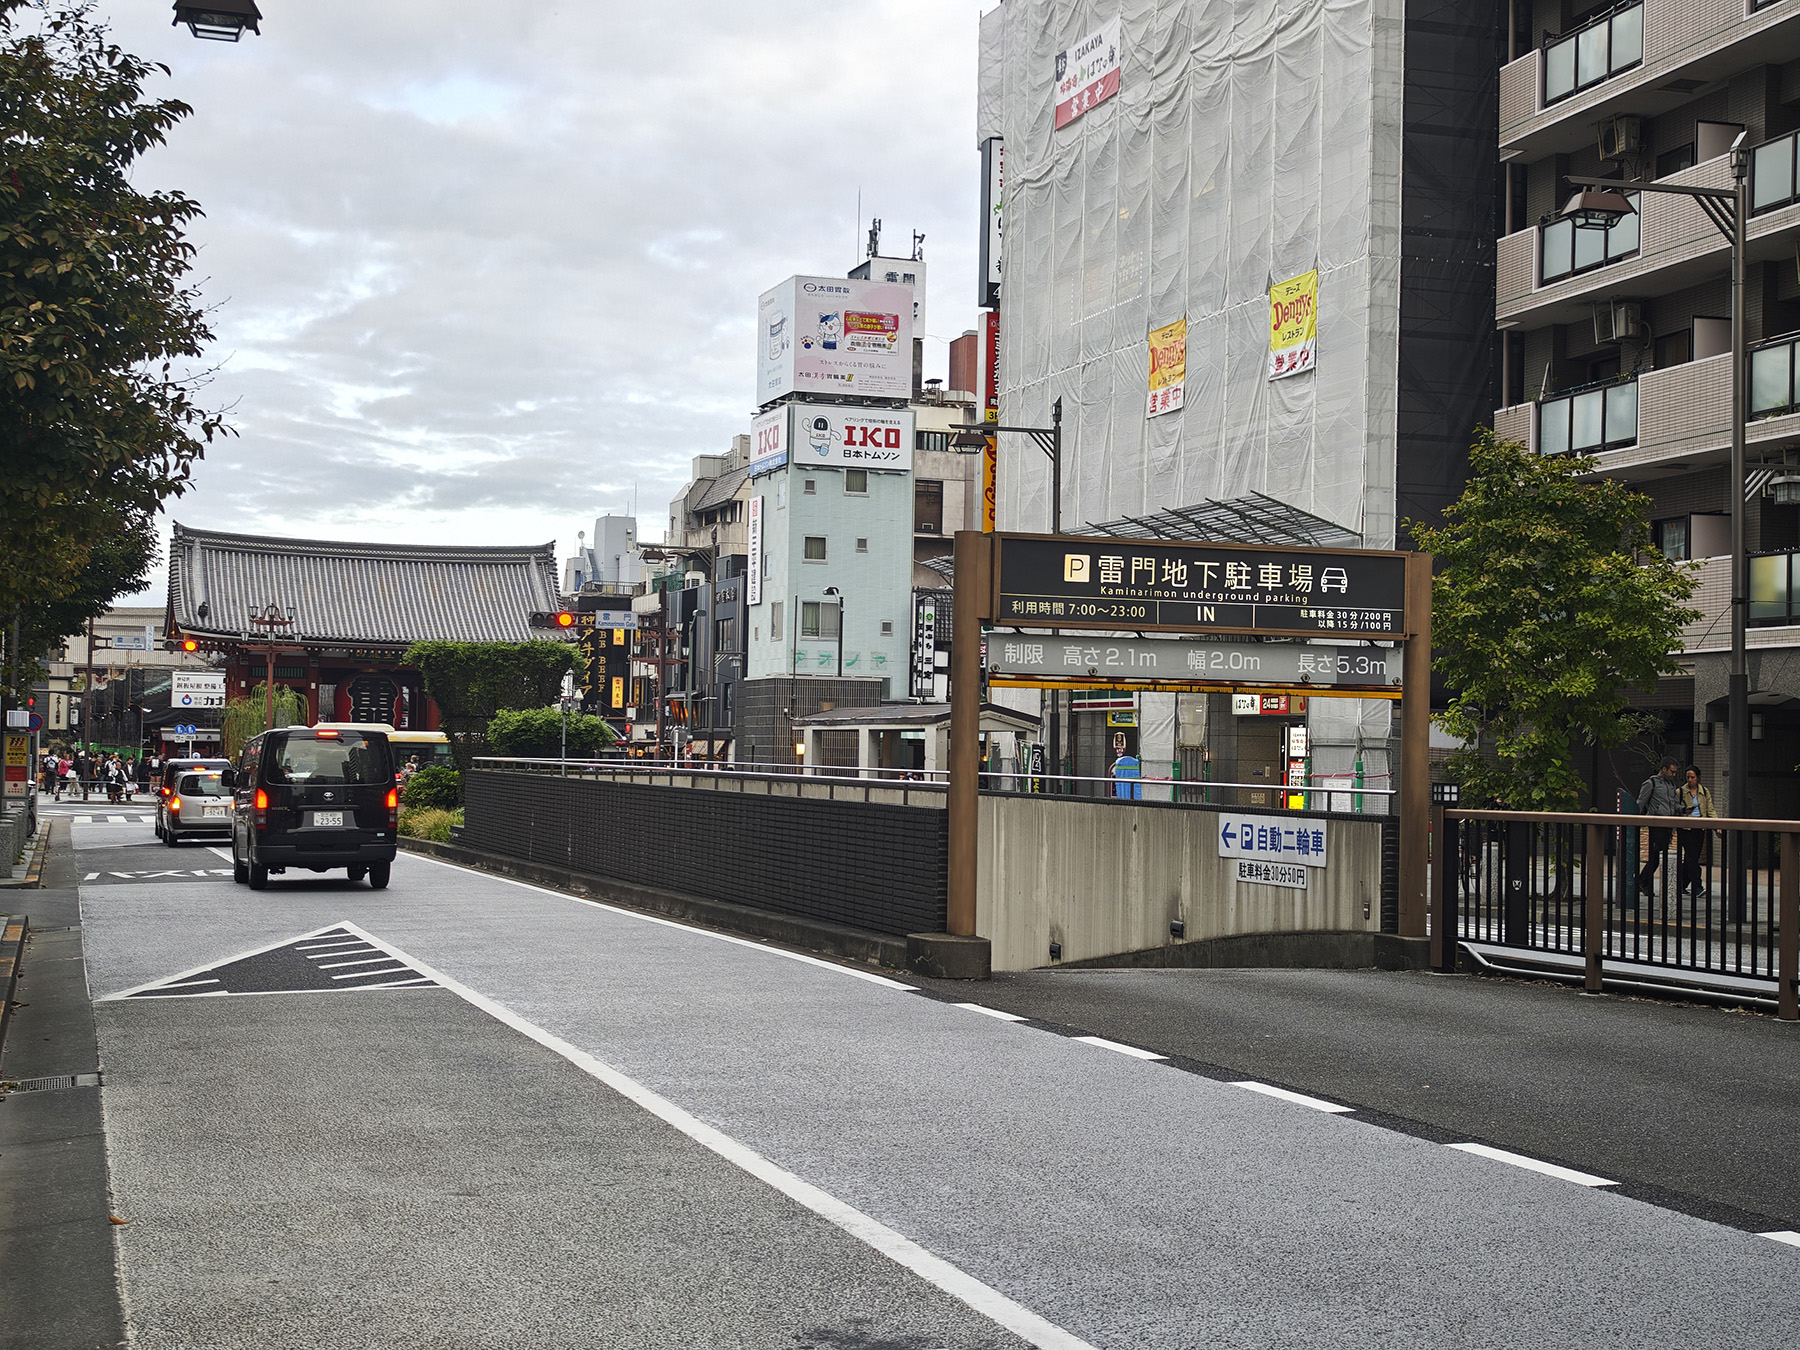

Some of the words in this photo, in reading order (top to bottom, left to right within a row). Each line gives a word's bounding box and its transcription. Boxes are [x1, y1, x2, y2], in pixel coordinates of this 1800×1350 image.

[1074, 34, 1103, 62] IZAKAYA
[1071, 81, 1104, 118] 営業中
[1286, 283, 1301, 296] デニーズ
[1273, 288, 1312, 330] Denny's
[1282, 328, 1304, 342] レストラン
[1274, 349, 1309, 374] 営業中
[1150, 388, 1181, 413] 営業中
[758, 425, 779, 455] IKO
[844, 425, 900, 448] IKO
[844, 449, 900, 460] 日本トムソン
[1098, 554, 1314, 593] 雷門地下駐車場
[1100, 586, 1178, 598] Kaminarimon
[1182, 589, 1259, 603] underground
[1265, 592, 1308, 605] parking
[1012, 601, 1064, 616] 利用時間
[1197, 606, 1216, 622] IN
[598, 630, 607, 648] BE
[1004, 643, 1044, 666] 制限
[598, 656, 607, 692] BEEF
[1258, 825, 1324, 856] 自動二輪車
[1239, 862, 1305, 885] 駐車料金30分50円
